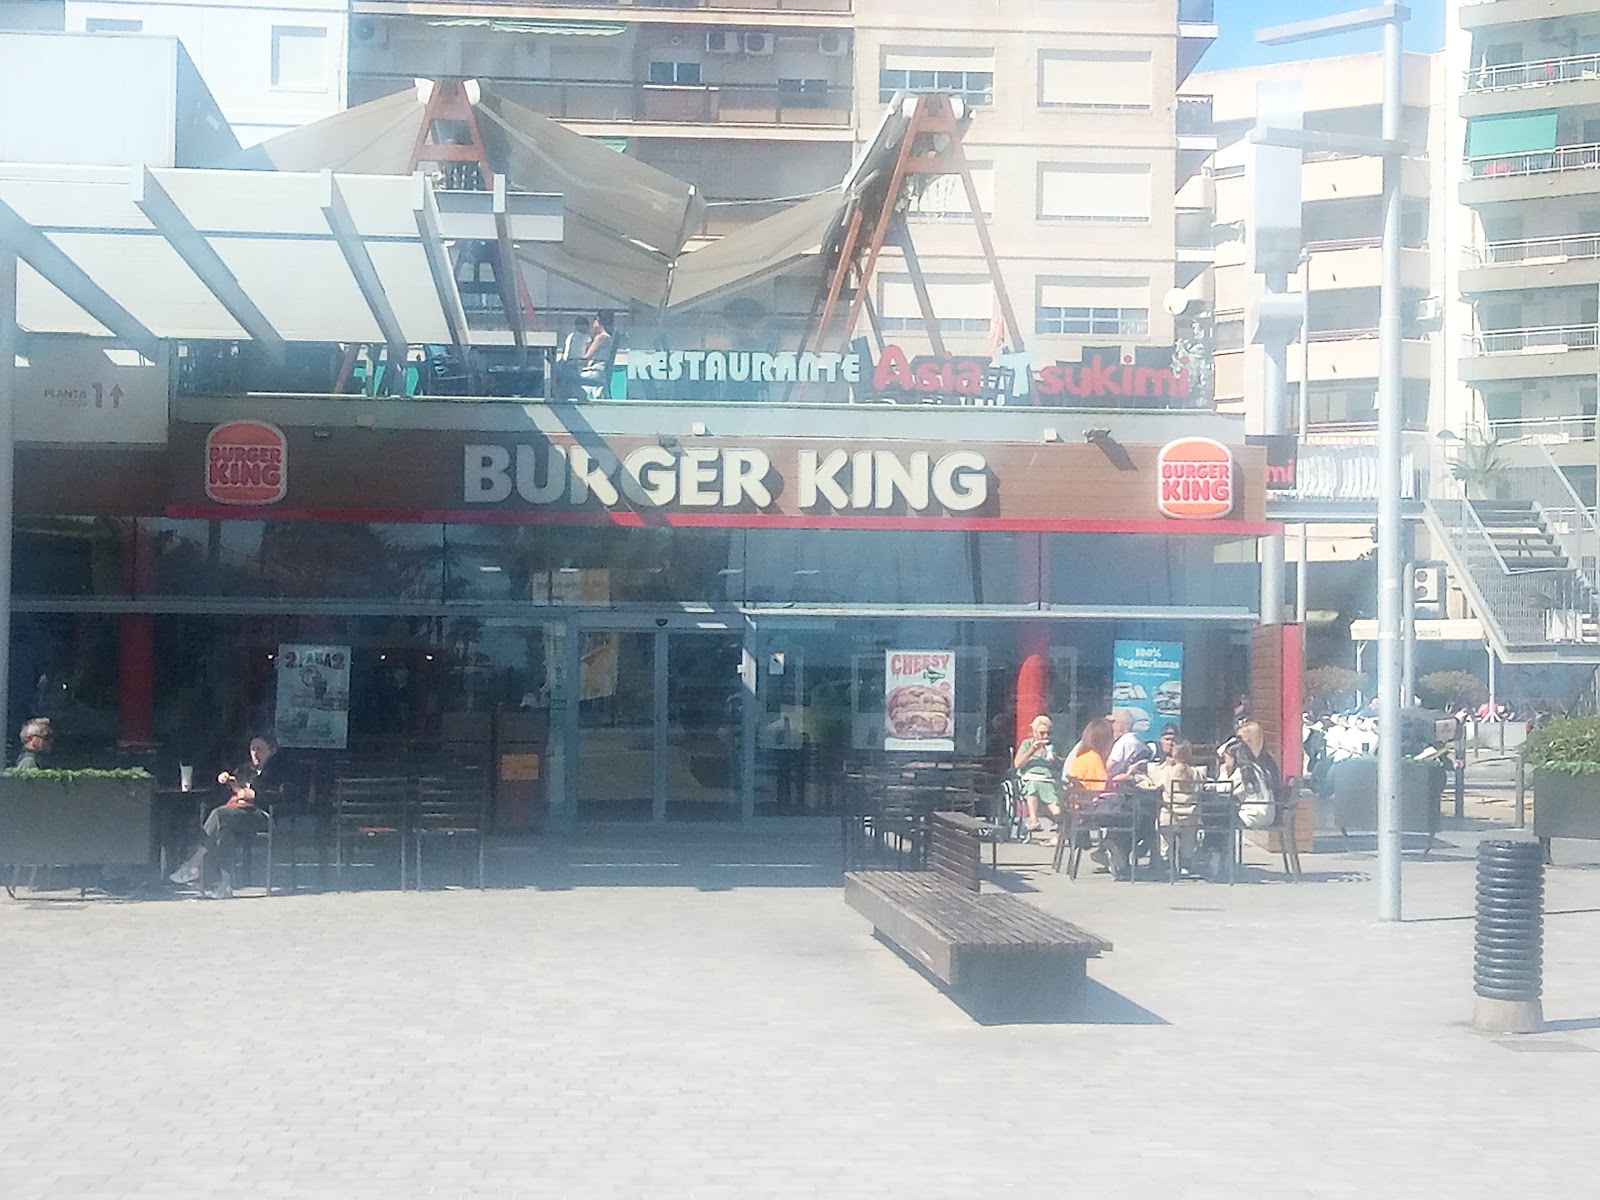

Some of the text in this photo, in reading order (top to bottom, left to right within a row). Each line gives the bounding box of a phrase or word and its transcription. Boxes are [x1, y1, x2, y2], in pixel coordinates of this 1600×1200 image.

[627, 351, 861, 382] RESTAURANTE
[873, 344, 984, 394] Asia
[92, 382, 102, 408] 1
[209, 446, 281, 463] BURGER
[209, 462, 281, 486] KING
[463, 444, 988, 511] BURGER KING
[1162, 464, 1230, 479] BURGER
[1162, 479, 1230, 501] KING
[890, 654, 950, 676] CHEESY
